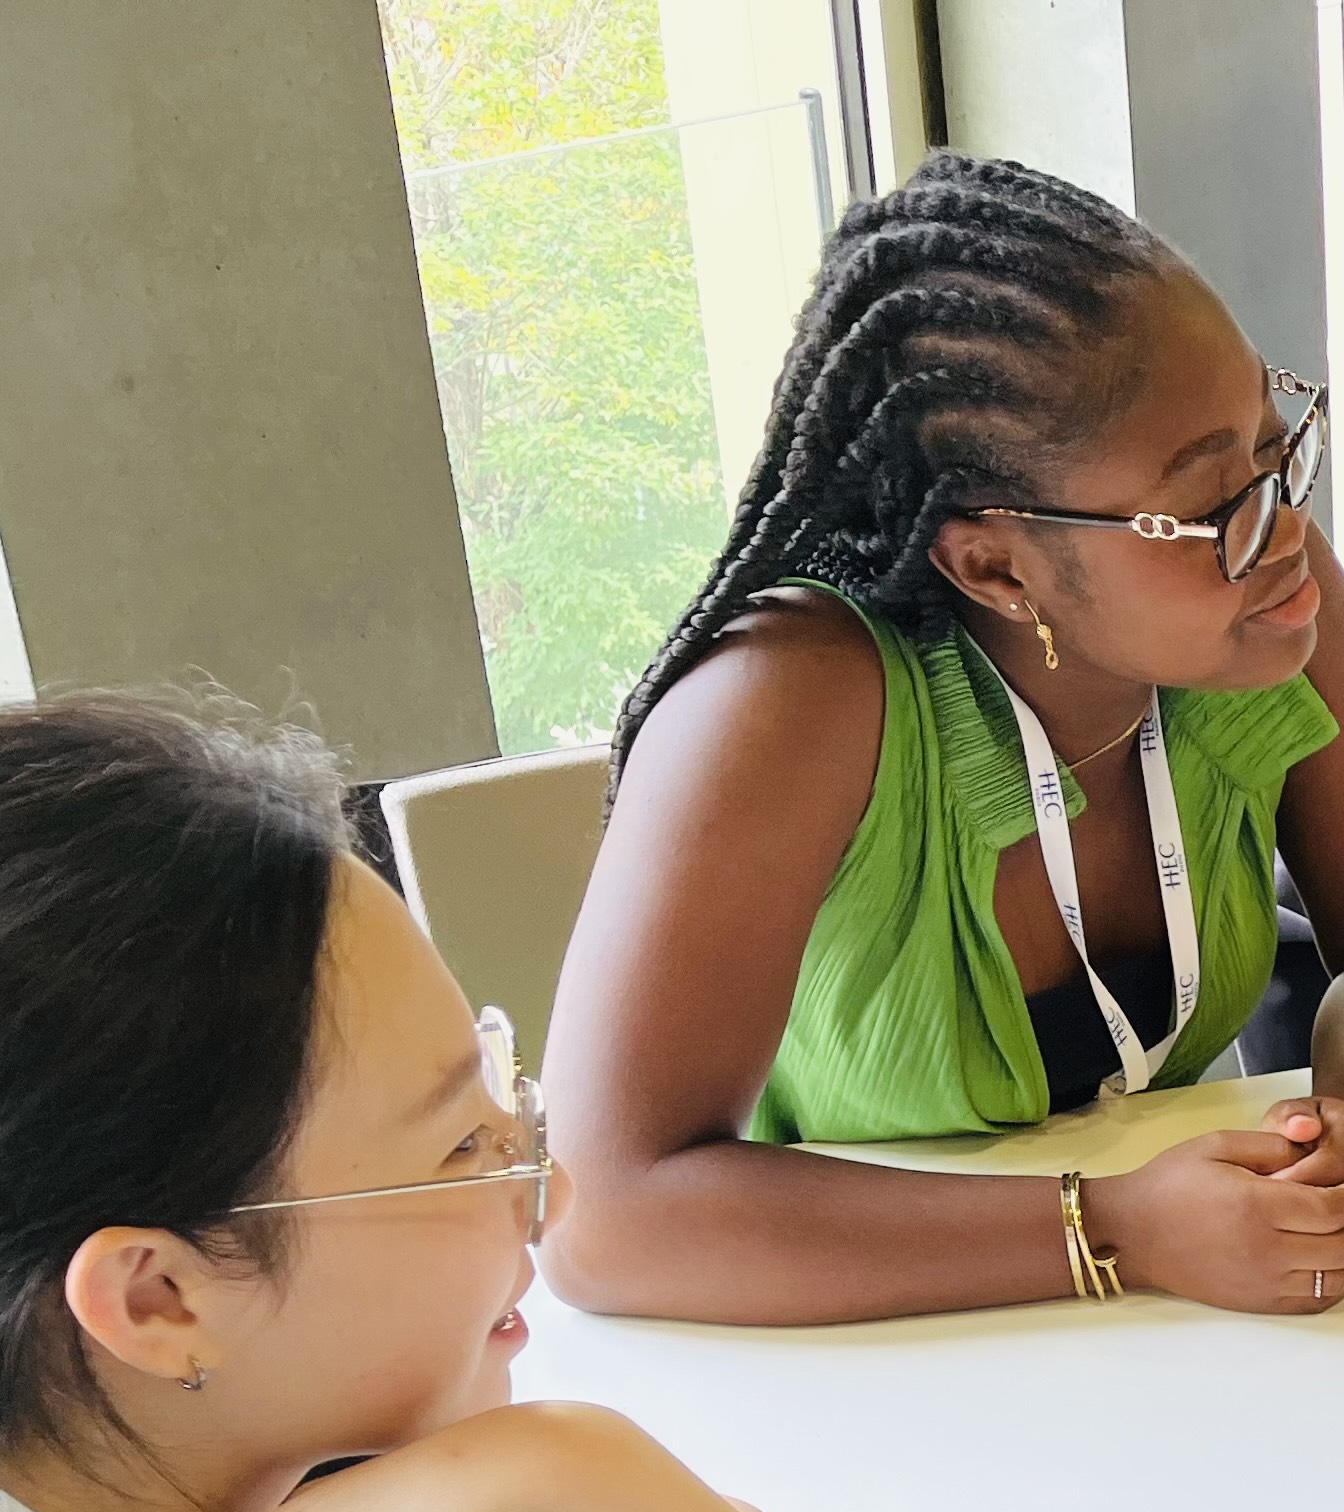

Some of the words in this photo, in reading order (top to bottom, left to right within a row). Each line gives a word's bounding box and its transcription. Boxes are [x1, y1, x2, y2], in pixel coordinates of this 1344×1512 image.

[1037, 768, 1062, 819] HEC
[1157, 841, 1181, 890] HEC
[1063, 902, 1083, 942] HEC
[1178, 972, 1195, 1014] HEC
